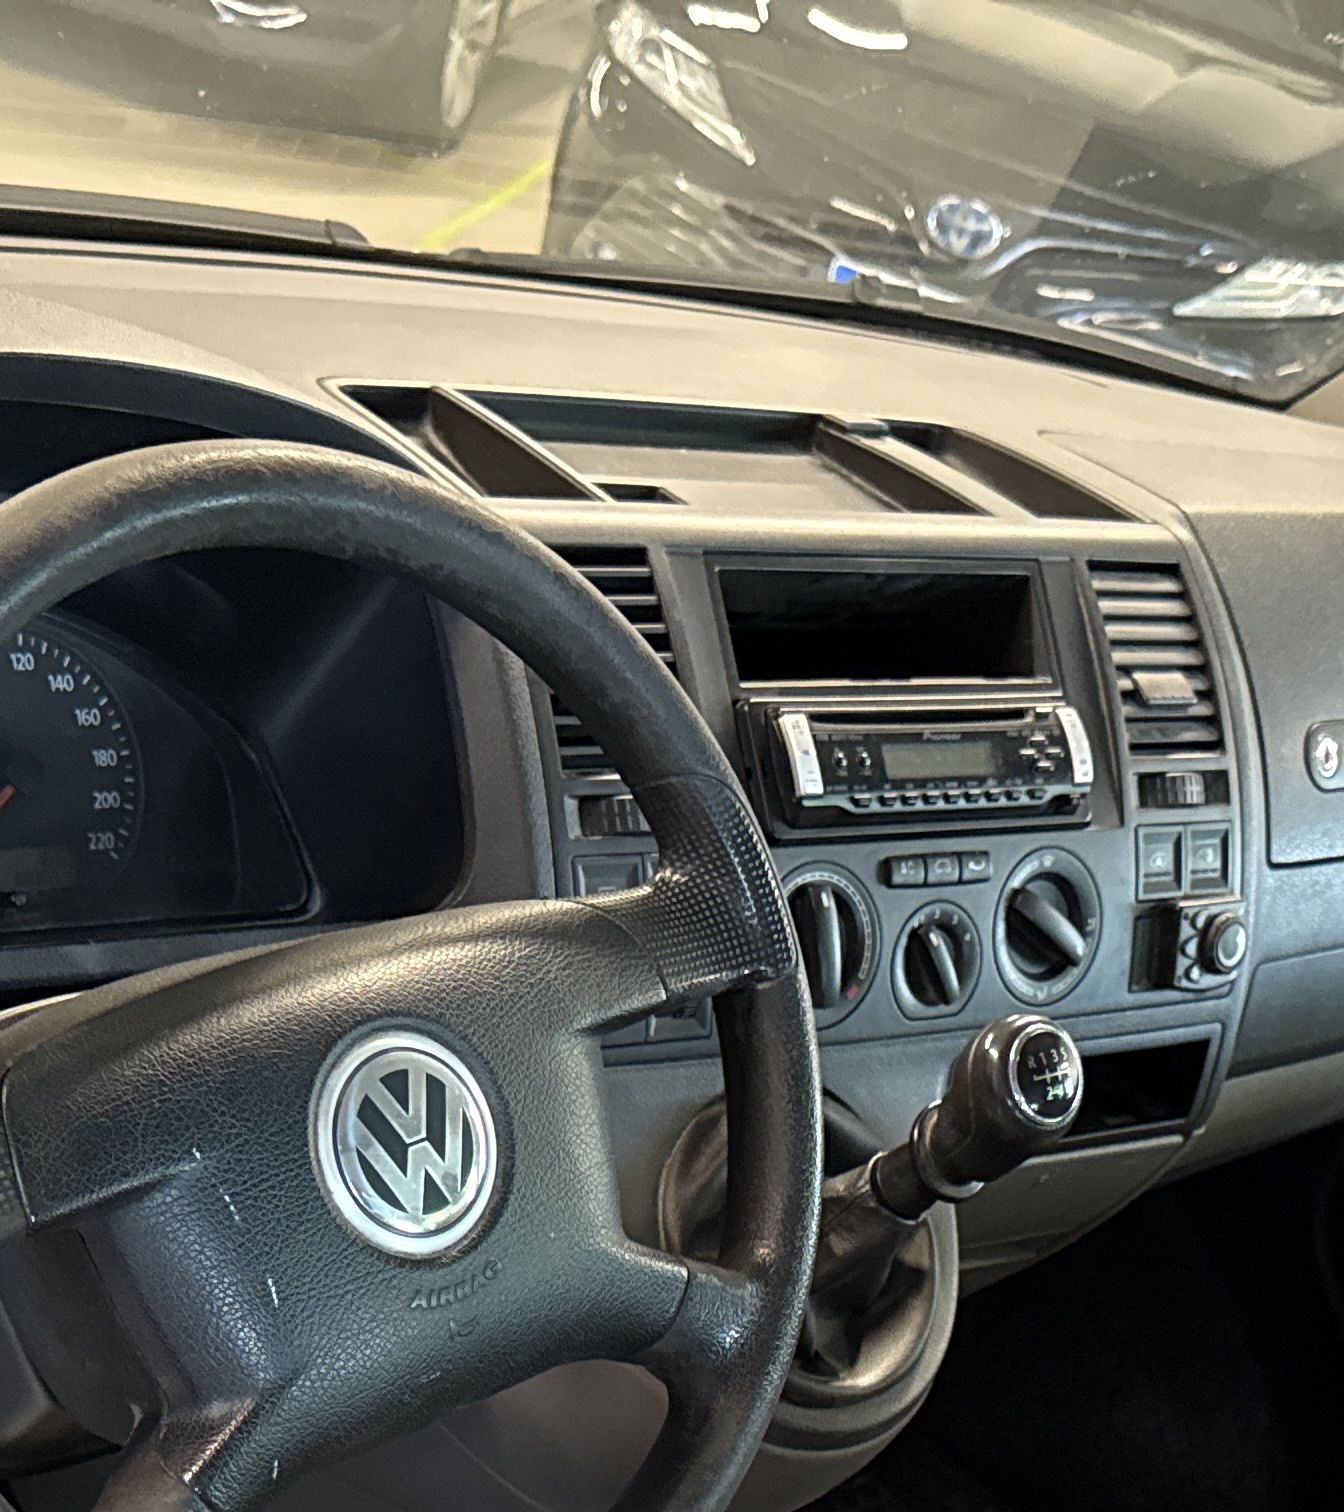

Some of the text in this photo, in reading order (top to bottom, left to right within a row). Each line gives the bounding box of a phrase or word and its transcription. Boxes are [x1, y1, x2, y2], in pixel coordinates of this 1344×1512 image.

[9, 652, 35, 671] 120
[47, 673, 75, 693] 140
[74, 708, 102, 727] 160
[91, 748, 118, 767] 180
[92, 791, 120, 809] 200
[87, 831, 115, 851] 220
